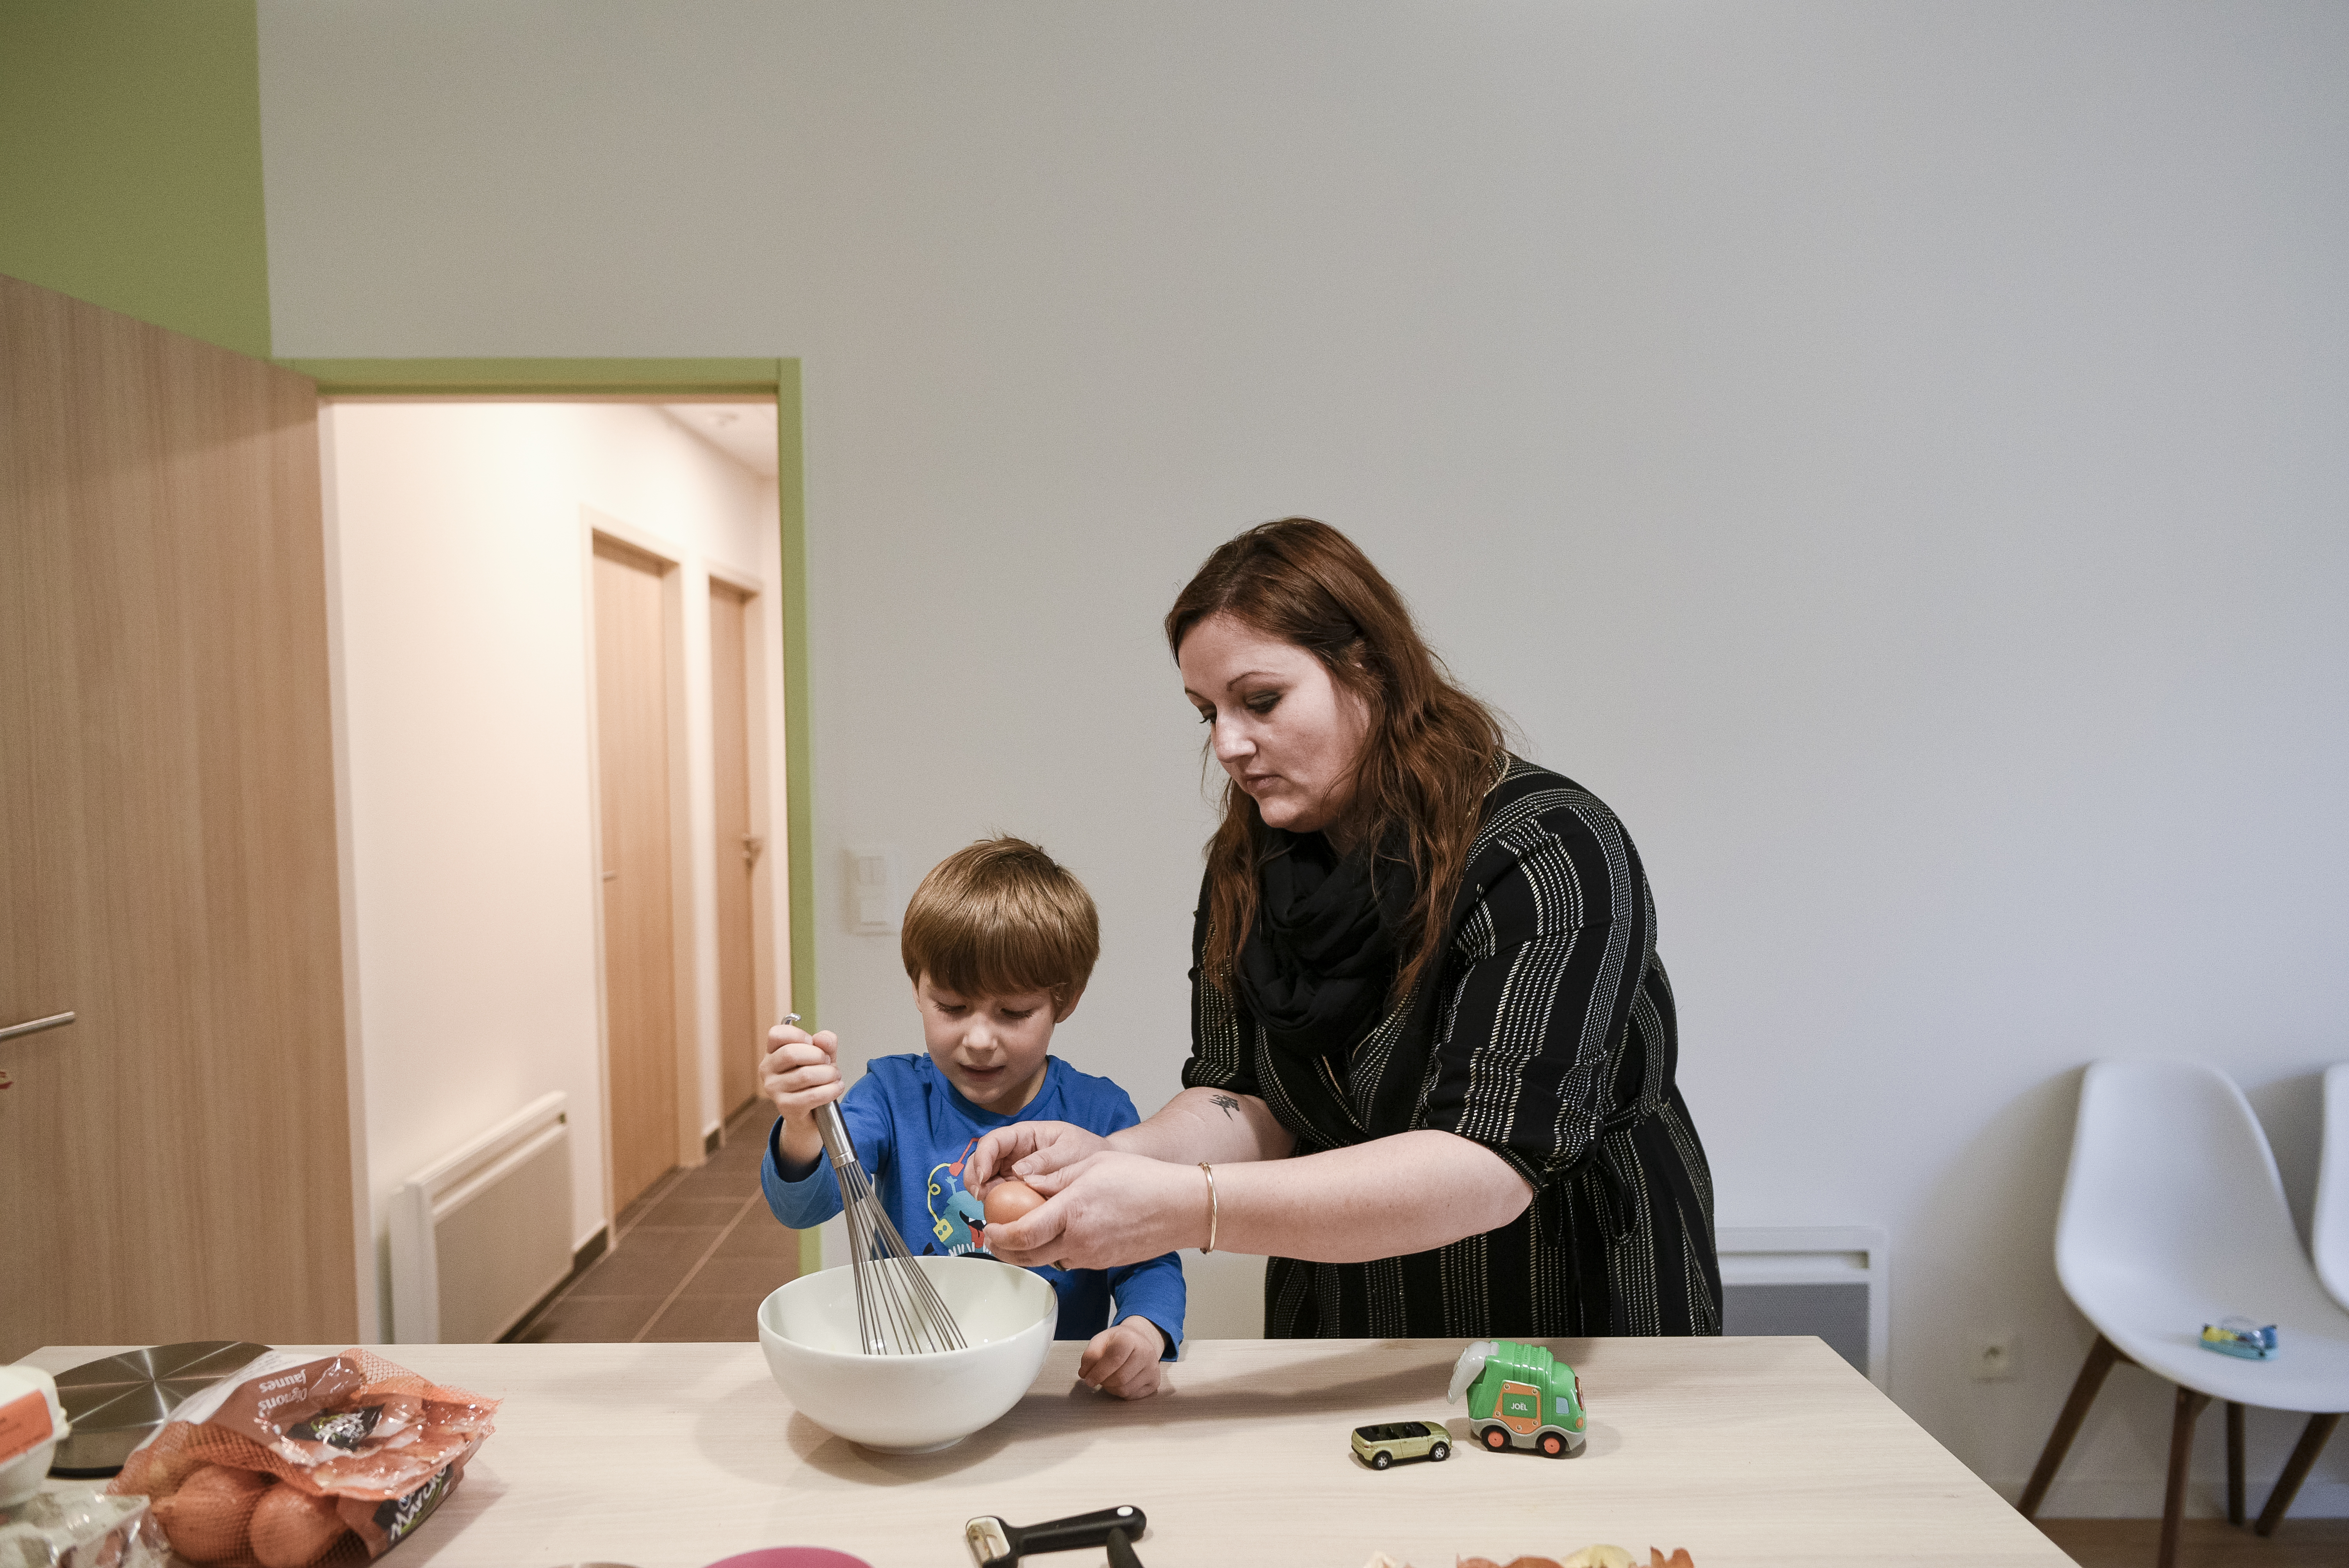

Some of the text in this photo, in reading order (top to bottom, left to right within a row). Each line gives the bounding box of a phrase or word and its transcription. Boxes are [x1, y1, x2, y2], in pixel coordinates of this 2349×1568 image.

[259, 1369, 306, 1393] Jaunes
[258, 1387, 307, 1410] Oignons
[1511, 1402, 1528, 1411] JOËL
